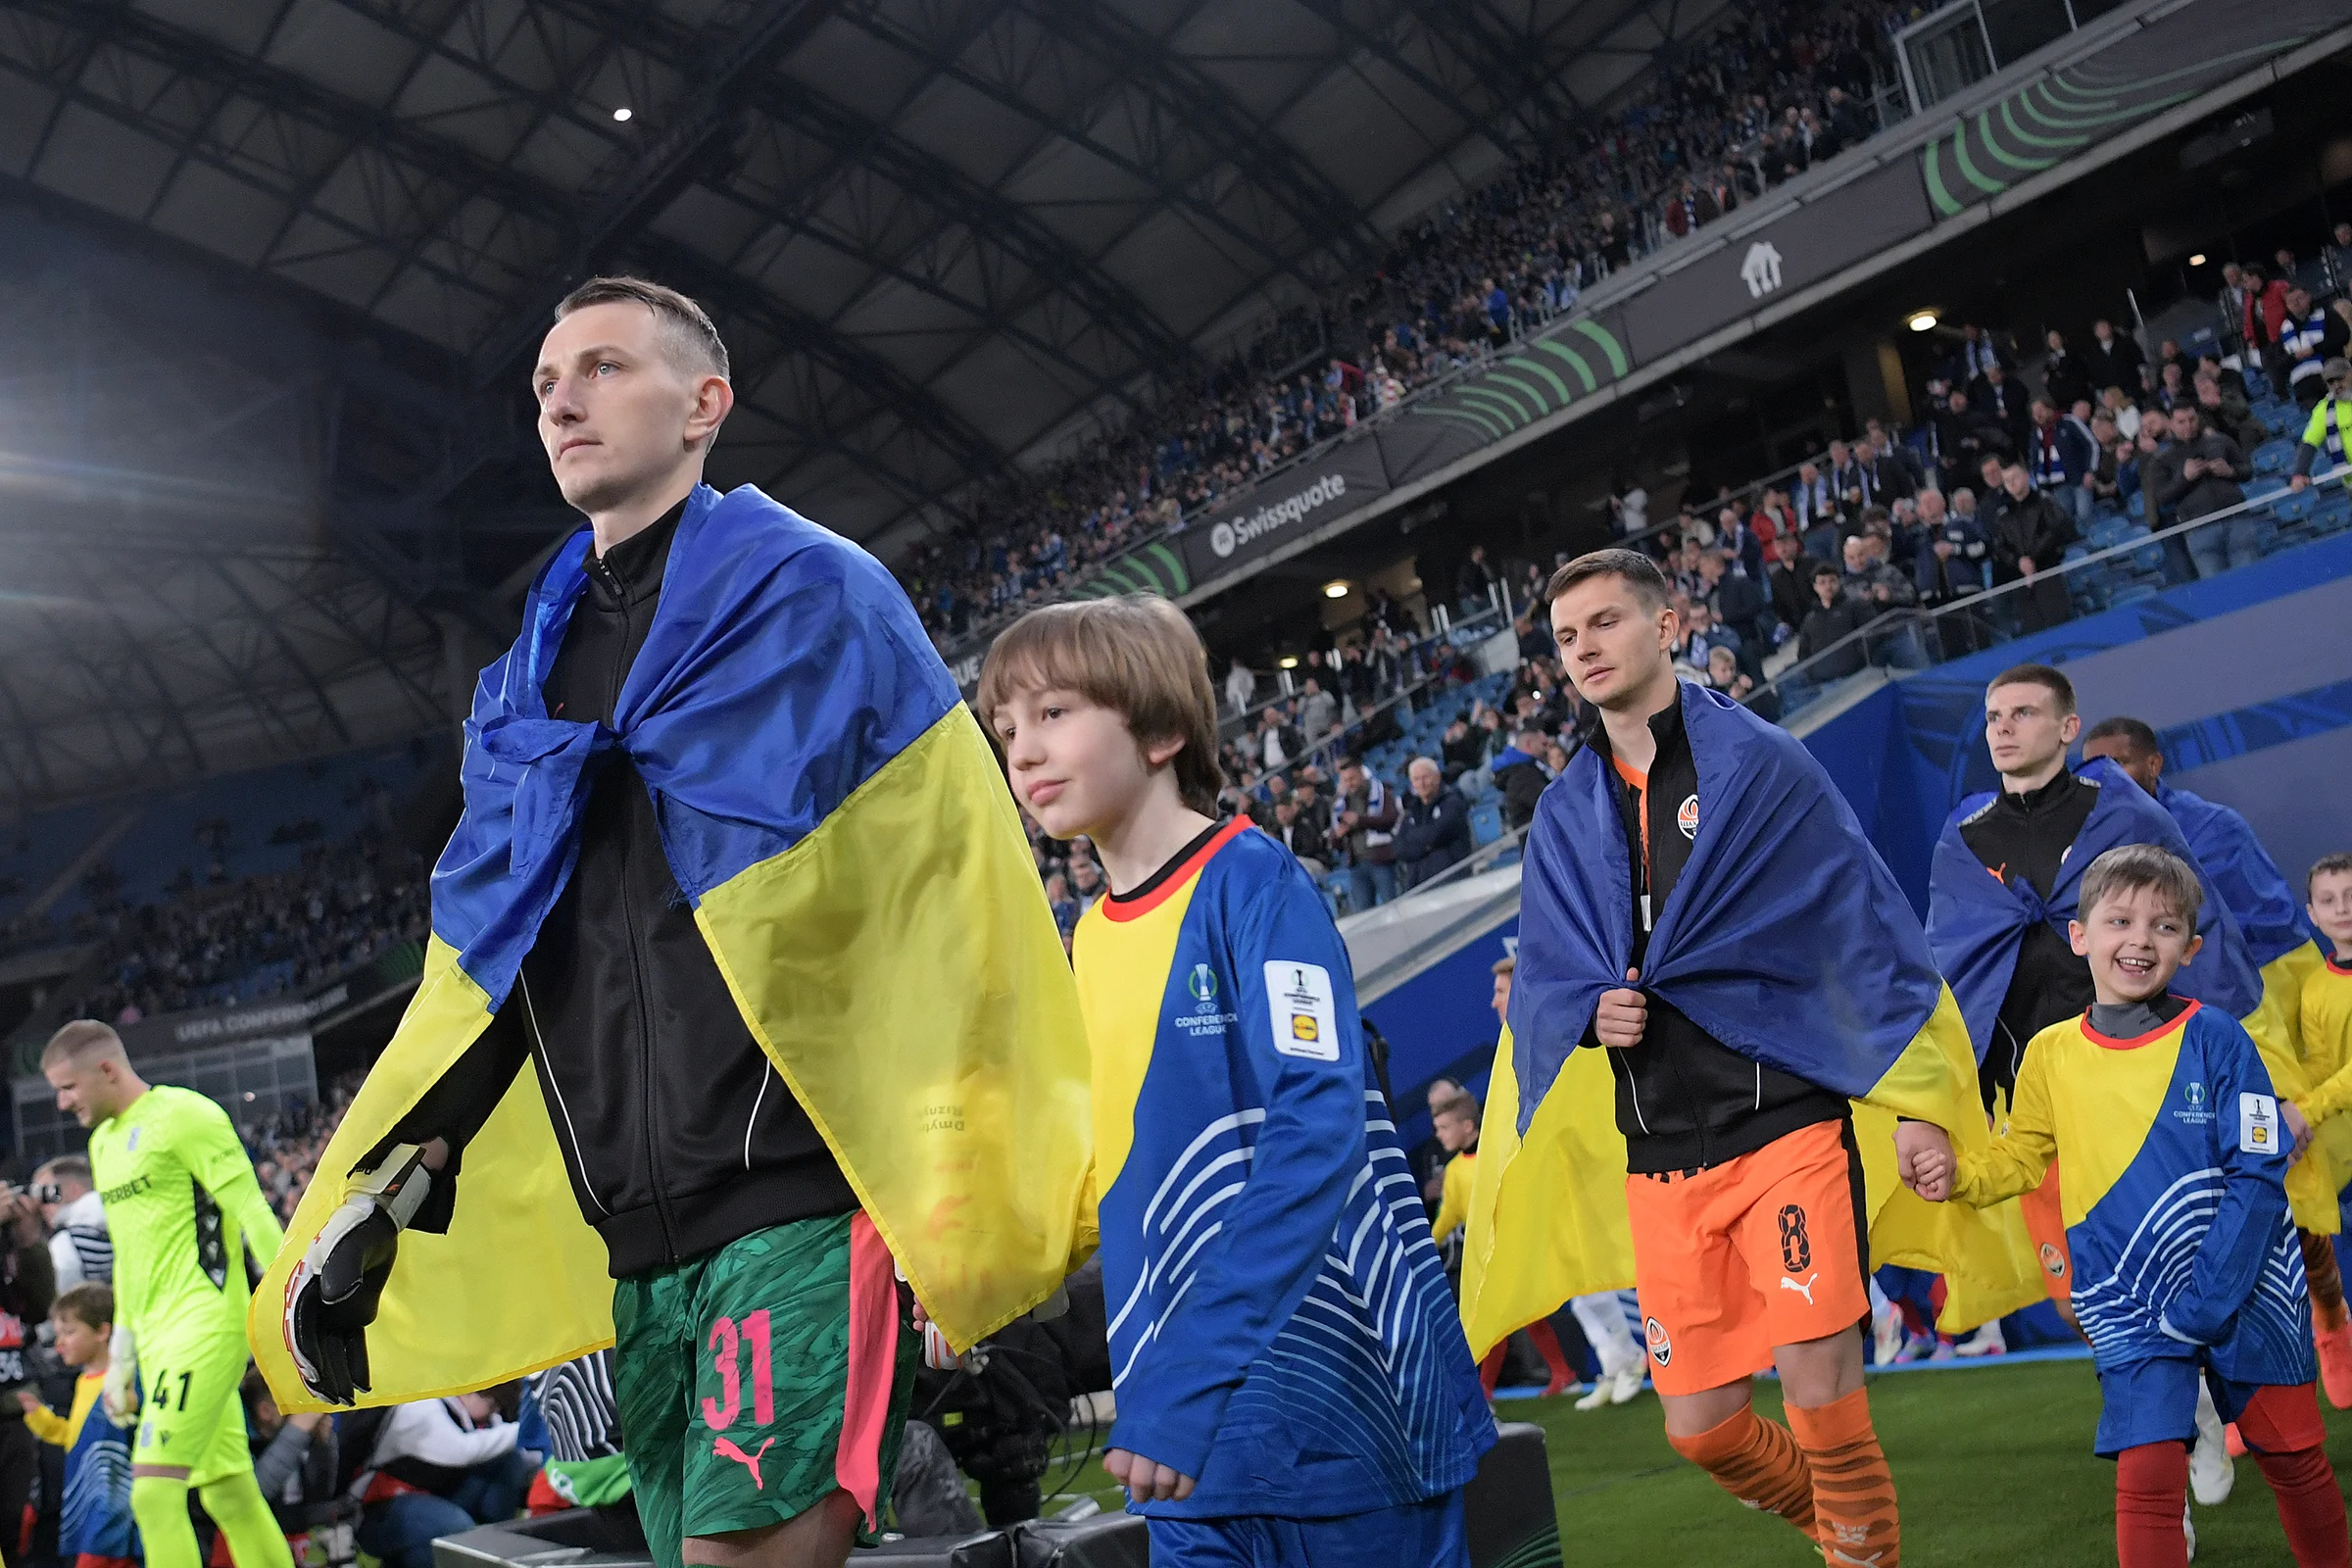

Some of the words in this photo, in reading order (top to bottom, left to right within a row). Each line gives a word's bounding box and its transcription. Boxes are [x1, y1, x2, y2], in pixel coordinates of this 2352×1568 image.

[1232, 474, 1346, 545] Swissquote
[1778, 1204, 1811, 1273] 8
[152, 1369, 192, 1411] 41
[701, 1308, 774, 1431] 31
